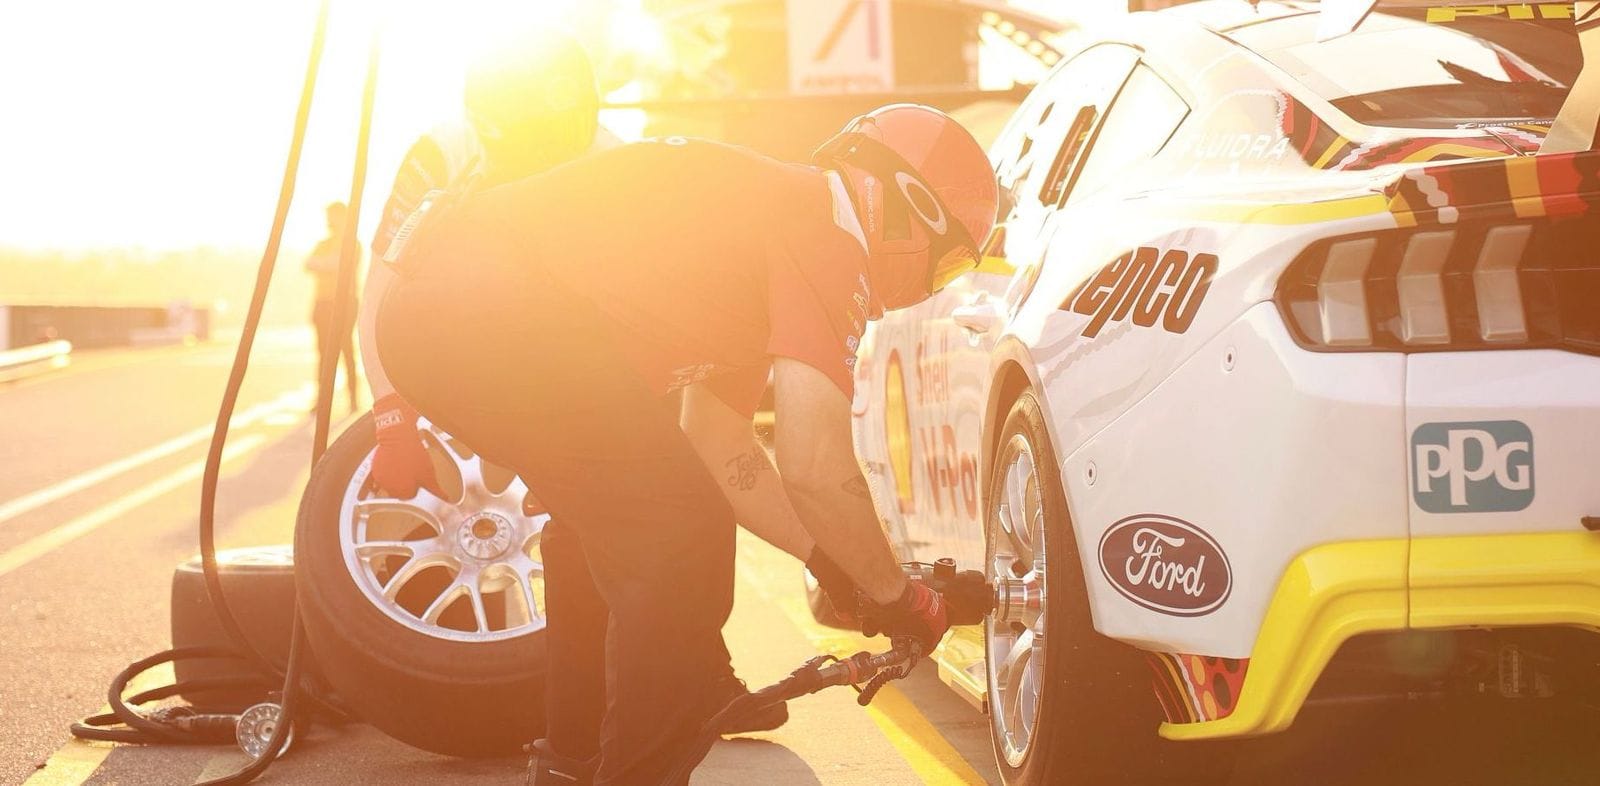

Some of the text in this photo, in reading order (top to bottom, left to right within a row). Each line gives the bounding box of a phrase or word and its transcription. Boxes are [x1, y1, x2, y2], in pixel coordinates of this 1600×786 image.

[1058, 246, 1219, 338] epco
[1416, 429, 1530, 506] PPG
[1125, 527, 1205, 597] Ford
